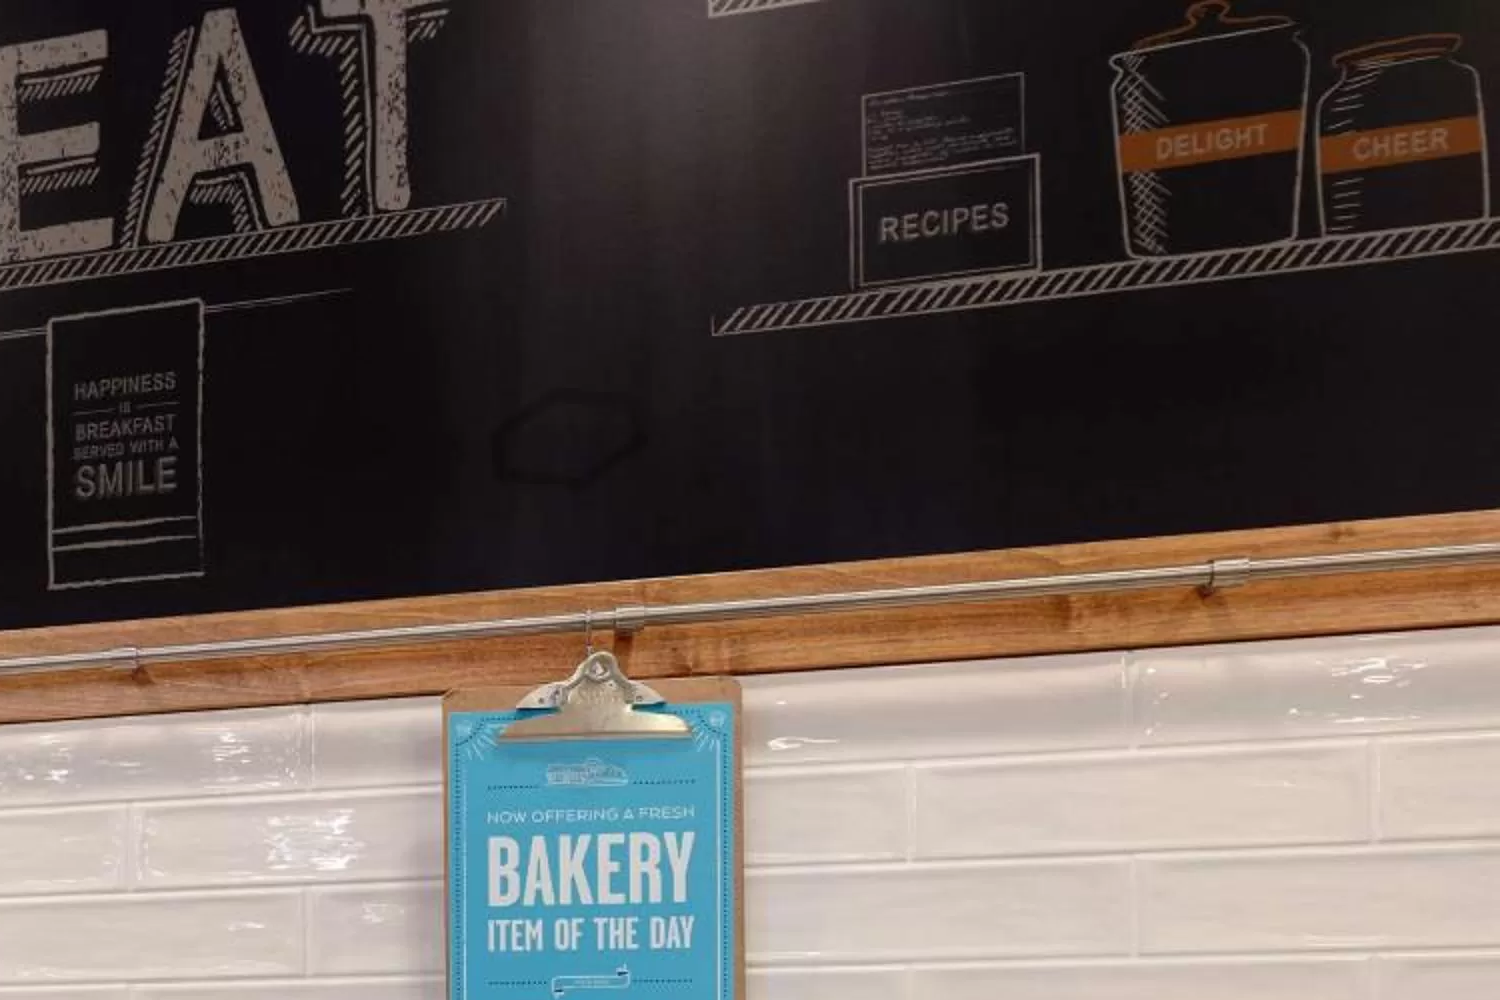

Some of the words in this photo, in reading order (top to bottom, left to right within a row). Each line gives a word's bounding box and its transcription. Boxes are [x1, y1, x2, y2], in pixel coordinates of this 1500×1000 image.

[1155, 123, 1269, 161] DELIGHT
[1353, 127, 1449, 161] CHEER
[879, 202, 1011, 243] RECIPES
[74, 371, 177, 400] HAPPINESS
[75, 414, 177, 441] BREAKFAST
[73, 442, 125, 460] SERVED
[130, 439, 164, 454] WITH
[168, 435, 179, 449] A
[76, 455, 177, 498] SMILE
[487, 810, 528, 824] NOW
[531, 808, 618, 824] OFFERING
[622, 807, 635, 818] A
[638, 806, 695, 820] FRESH
[487, 831, 695, 907] BAKERY
[487, 919, 544, 952] ITEM
[554, 918, 585, 951] OF
[593, 916, 640, 951] THE
[650, 915, 695, 949] DAY
